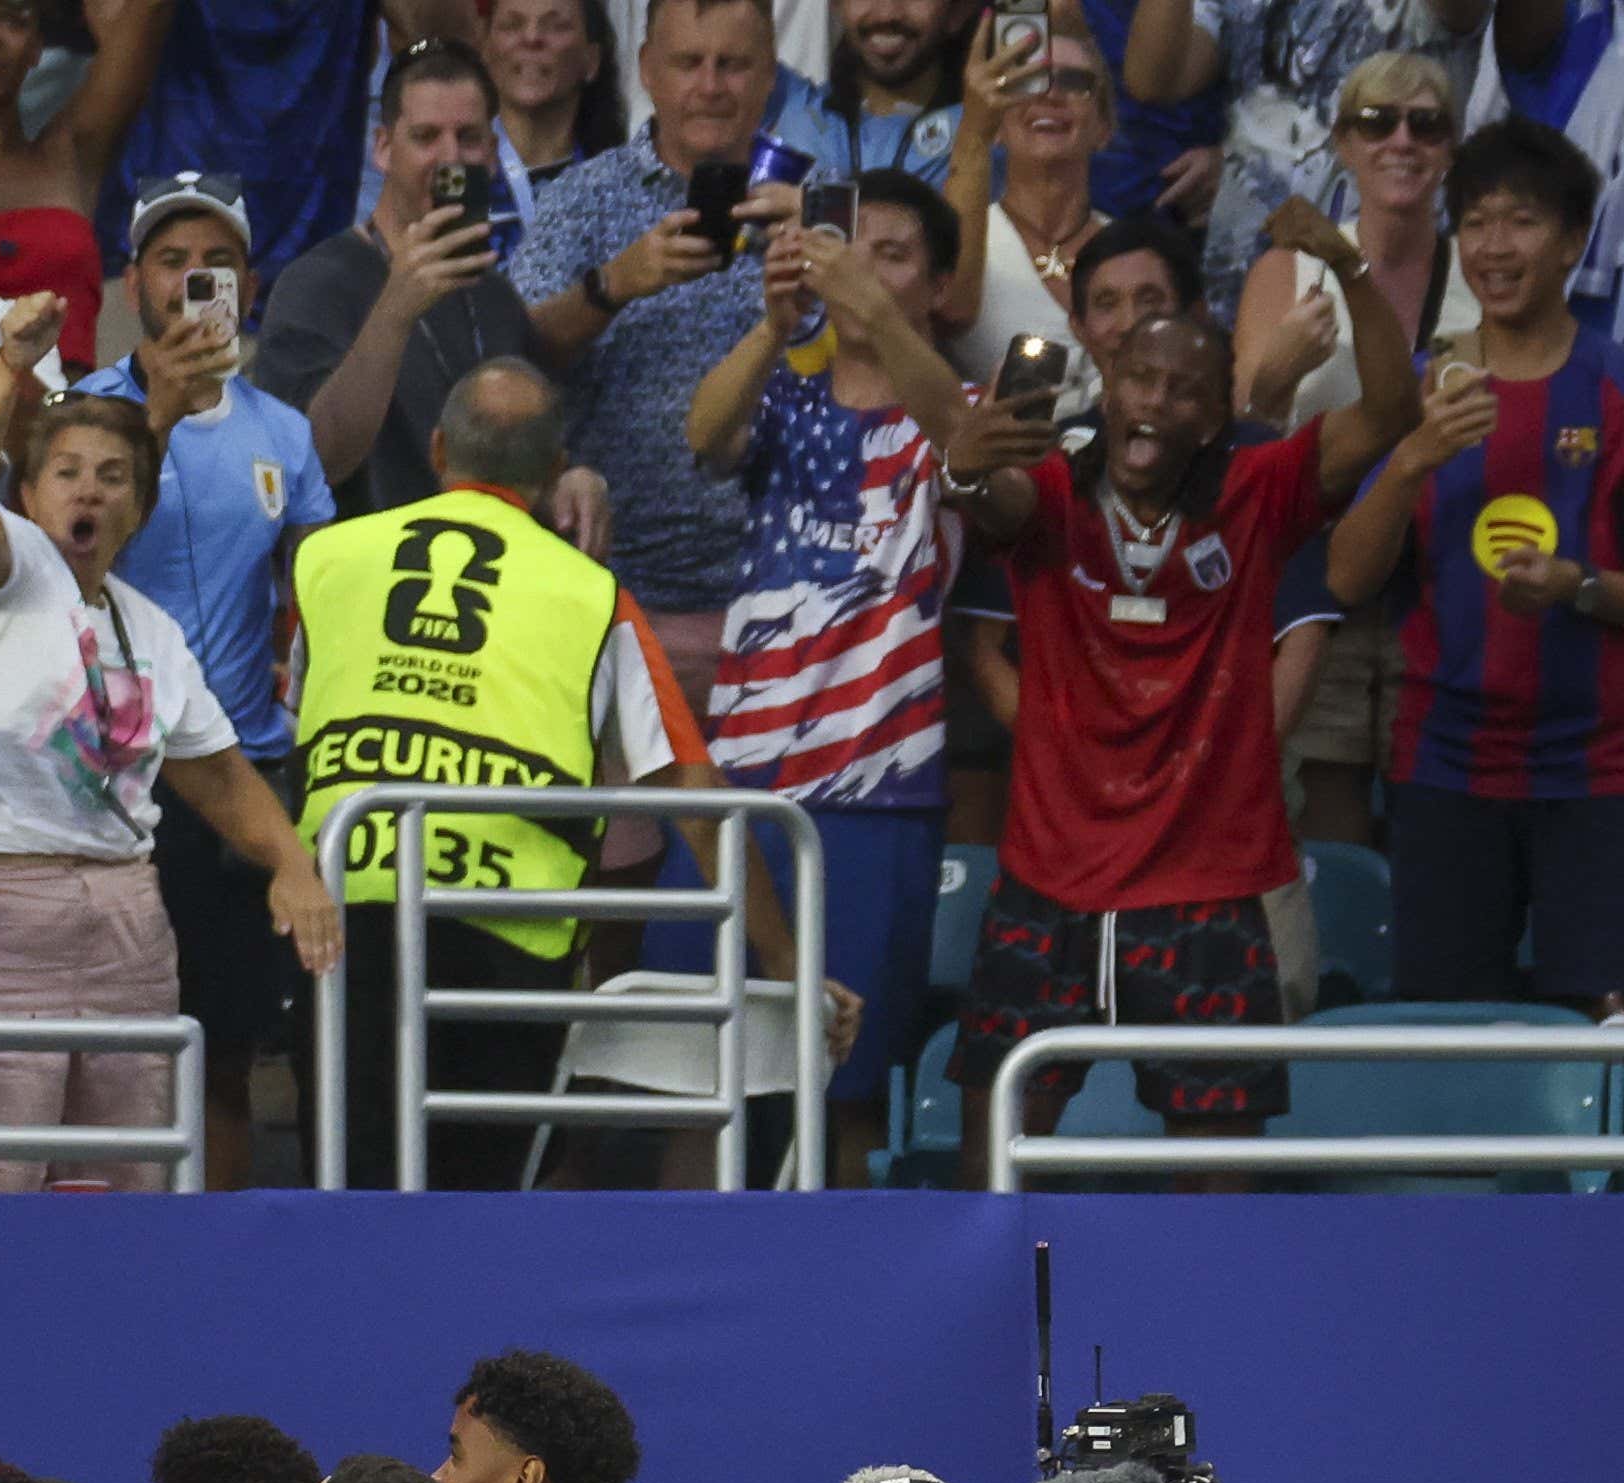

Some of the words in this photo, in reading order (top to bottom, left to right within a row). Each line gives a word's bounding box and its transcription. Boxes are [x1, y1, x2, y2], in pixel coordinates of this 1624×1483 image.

[409, 616, 460, 641] FIFA
[378, 655, 442, 673] WORLD
[446, 663, 482, 678] CUP
[373, 671, 477, 707] 2026
